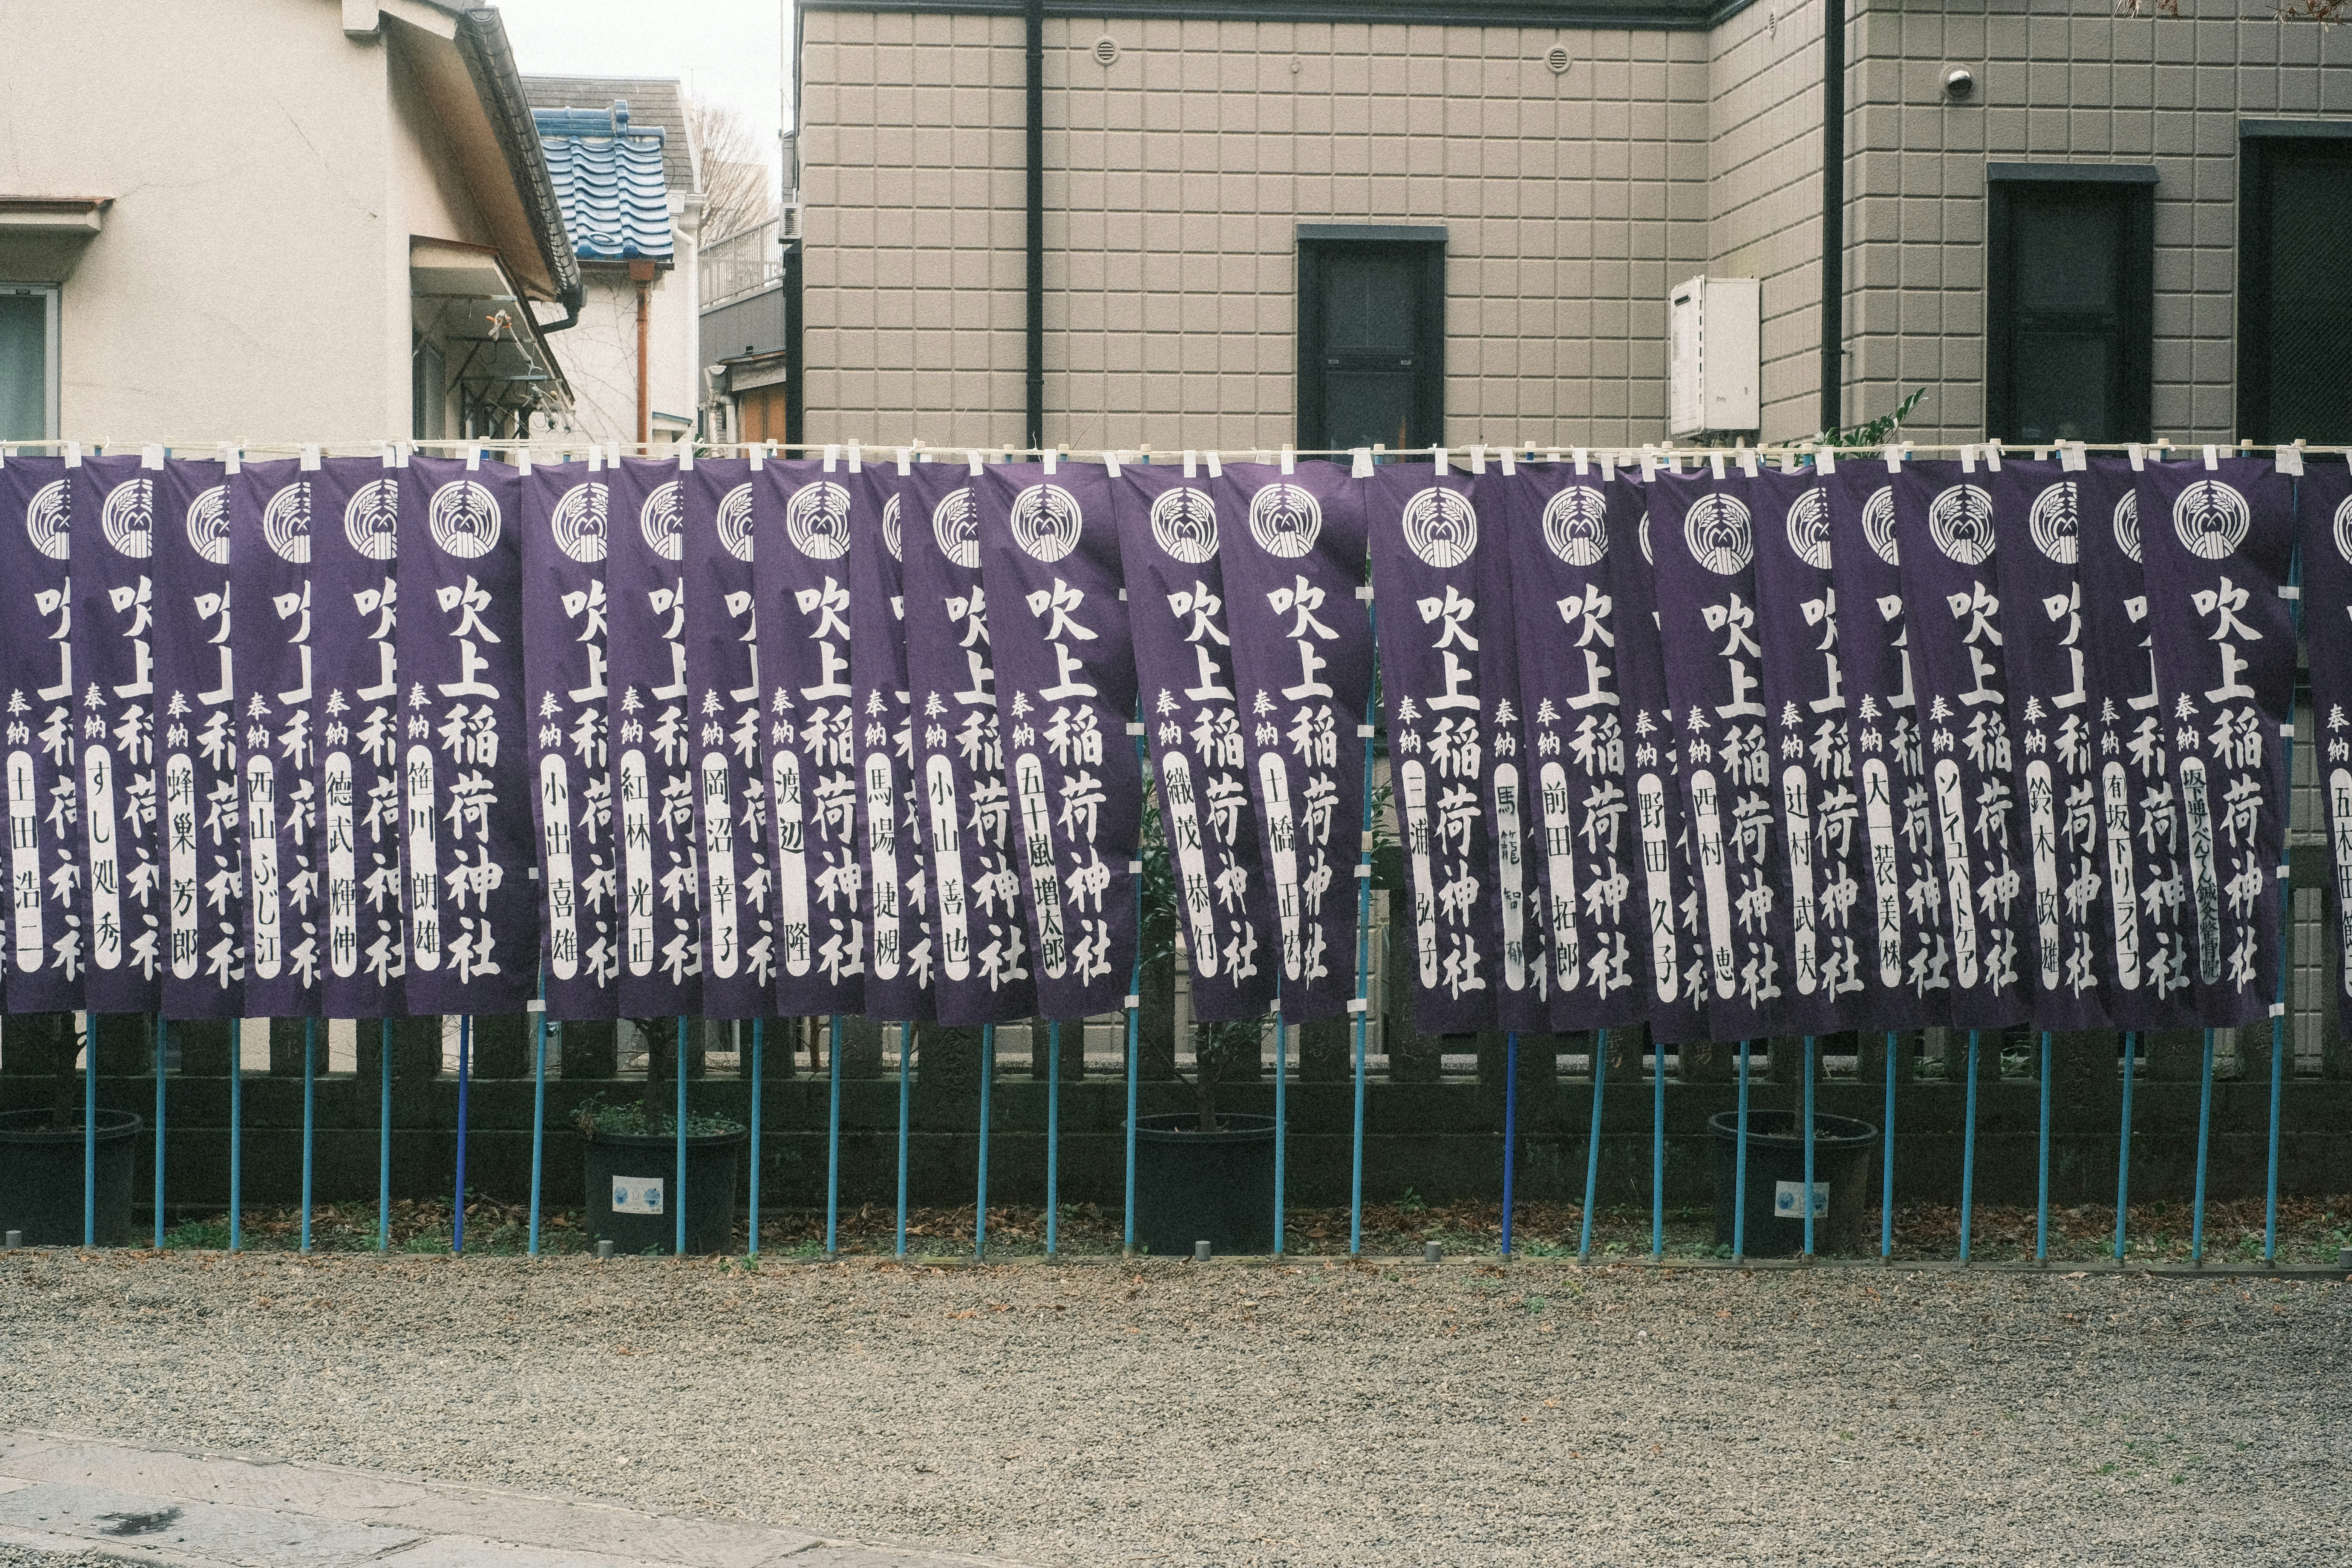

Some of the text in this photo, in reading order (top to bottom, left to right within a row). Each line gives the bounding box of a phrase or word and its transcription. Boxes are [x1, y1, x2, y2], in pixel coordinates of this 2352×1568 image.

[7, 688, 32, 745] 奉納
[84, 681, 107, 739] 奉納
[167, 691, 192, 748] 奉納
[247, 692, 272, 749] 奉納
[325, 689, 351, 747] 奉納
[408, 682, 432, 740] 奉納
[436, 575, 504, 984] 吹上稲荷神社
[539, 691, 563, 749] 奉納
[621, 686, 645, 744] 奉納
[701, 689, 724, 748] 奉納
[772, 687, 795, 745] 奉納
[795, 576, 864, 986] 吹上稲荷神社
[865, 689, 888, 747] 奉納
[925, 691, 948, 749] 奉納
[945, 585, 1028, 992] 吹上稲荷神社
[1011, 691, 1034, 749] 奉納
[1026, 577, 1110, 987] 吹上稲荷神社
[1156, 688, 1182, 746] 奉納
[1167, 580, 1257, 988] 吹上稲荷神社
[1253, 689, 1277, 747] 奉納
[1267, 574, 1340, 990] 吹上稲荷神社
[1398, 695, 1422, 754] 奉納
[1416, 585, 1486, 1000] 吹上稲荷神社
[1494, 698, 1518, 757] 奉納
[1536, 698, 1561, 757] 奉納
[1556, 583, 1632, 1000] 吹上稲荷神社
[1635, 709, 1657, 768] 奉納
[1687, 705, 1711, 764] 奉納
[1701, 593, 1781, 1010] 吹上稲荷神社
[1781, 701, 1803, 760] 奉納
[1859, 694, 1882, 752] 奉納
[1929, 695, 1954, 754] 奉納
[1946, 580, 2020, 997] 吹上稲荷神社
[2023, 695, 2047, 755] 奉納
[2100, 697, 2120, 755] 奉納
[2174, 692, 2199, 752] 奉納
[2191, 576, 2263, 994] 吹上稲荷神社
[2327, 703, 2350, 763] 奉納
[10, 767, 42, 951] 土田浩二
[88, 761, 121, 953] すし処秀
[167, 767, 198, 965] 蜂巣芳郎
[249, 772, 280, 964] 西山ふじ江
[326, 770, 356, 964] 徳武輝伸
[408, 761, 439, 954] 笹川朗雄
[544, 772, 577, 962] 小出喜雄
[622, 767, 653, 963] 紅林光正
[703, 768, 737, 962] 岡沼幸子
[775, 767, 810, 963] 渡辺隆
[869, 769, 900, 967] 馬場捷槻
[931, 771, 969, 963] 小山善也
[1020, 765, 1065, 971] 五十嵐増太郎
[1166, 767, 1214, 961] 織茂恭行
[1265, 769, 1300, 964] 土橋正宏
[1407, 777, 1436, 970] 三浦弘子
[1497, 786, 1523, 966] 馬籠智郁
[1543, 781, 1577, 976] 前田拓郎
[1639, 792, 1676, 985] 野田久子
[1694, 788, 1733, 981] 西村恵
[1785, 784, 1816, 980] 辻村武夫
[1939, 773, 1974, 973] ソレイユハートケア
[2028, 776, 2058, 973] 鈴木政雄
